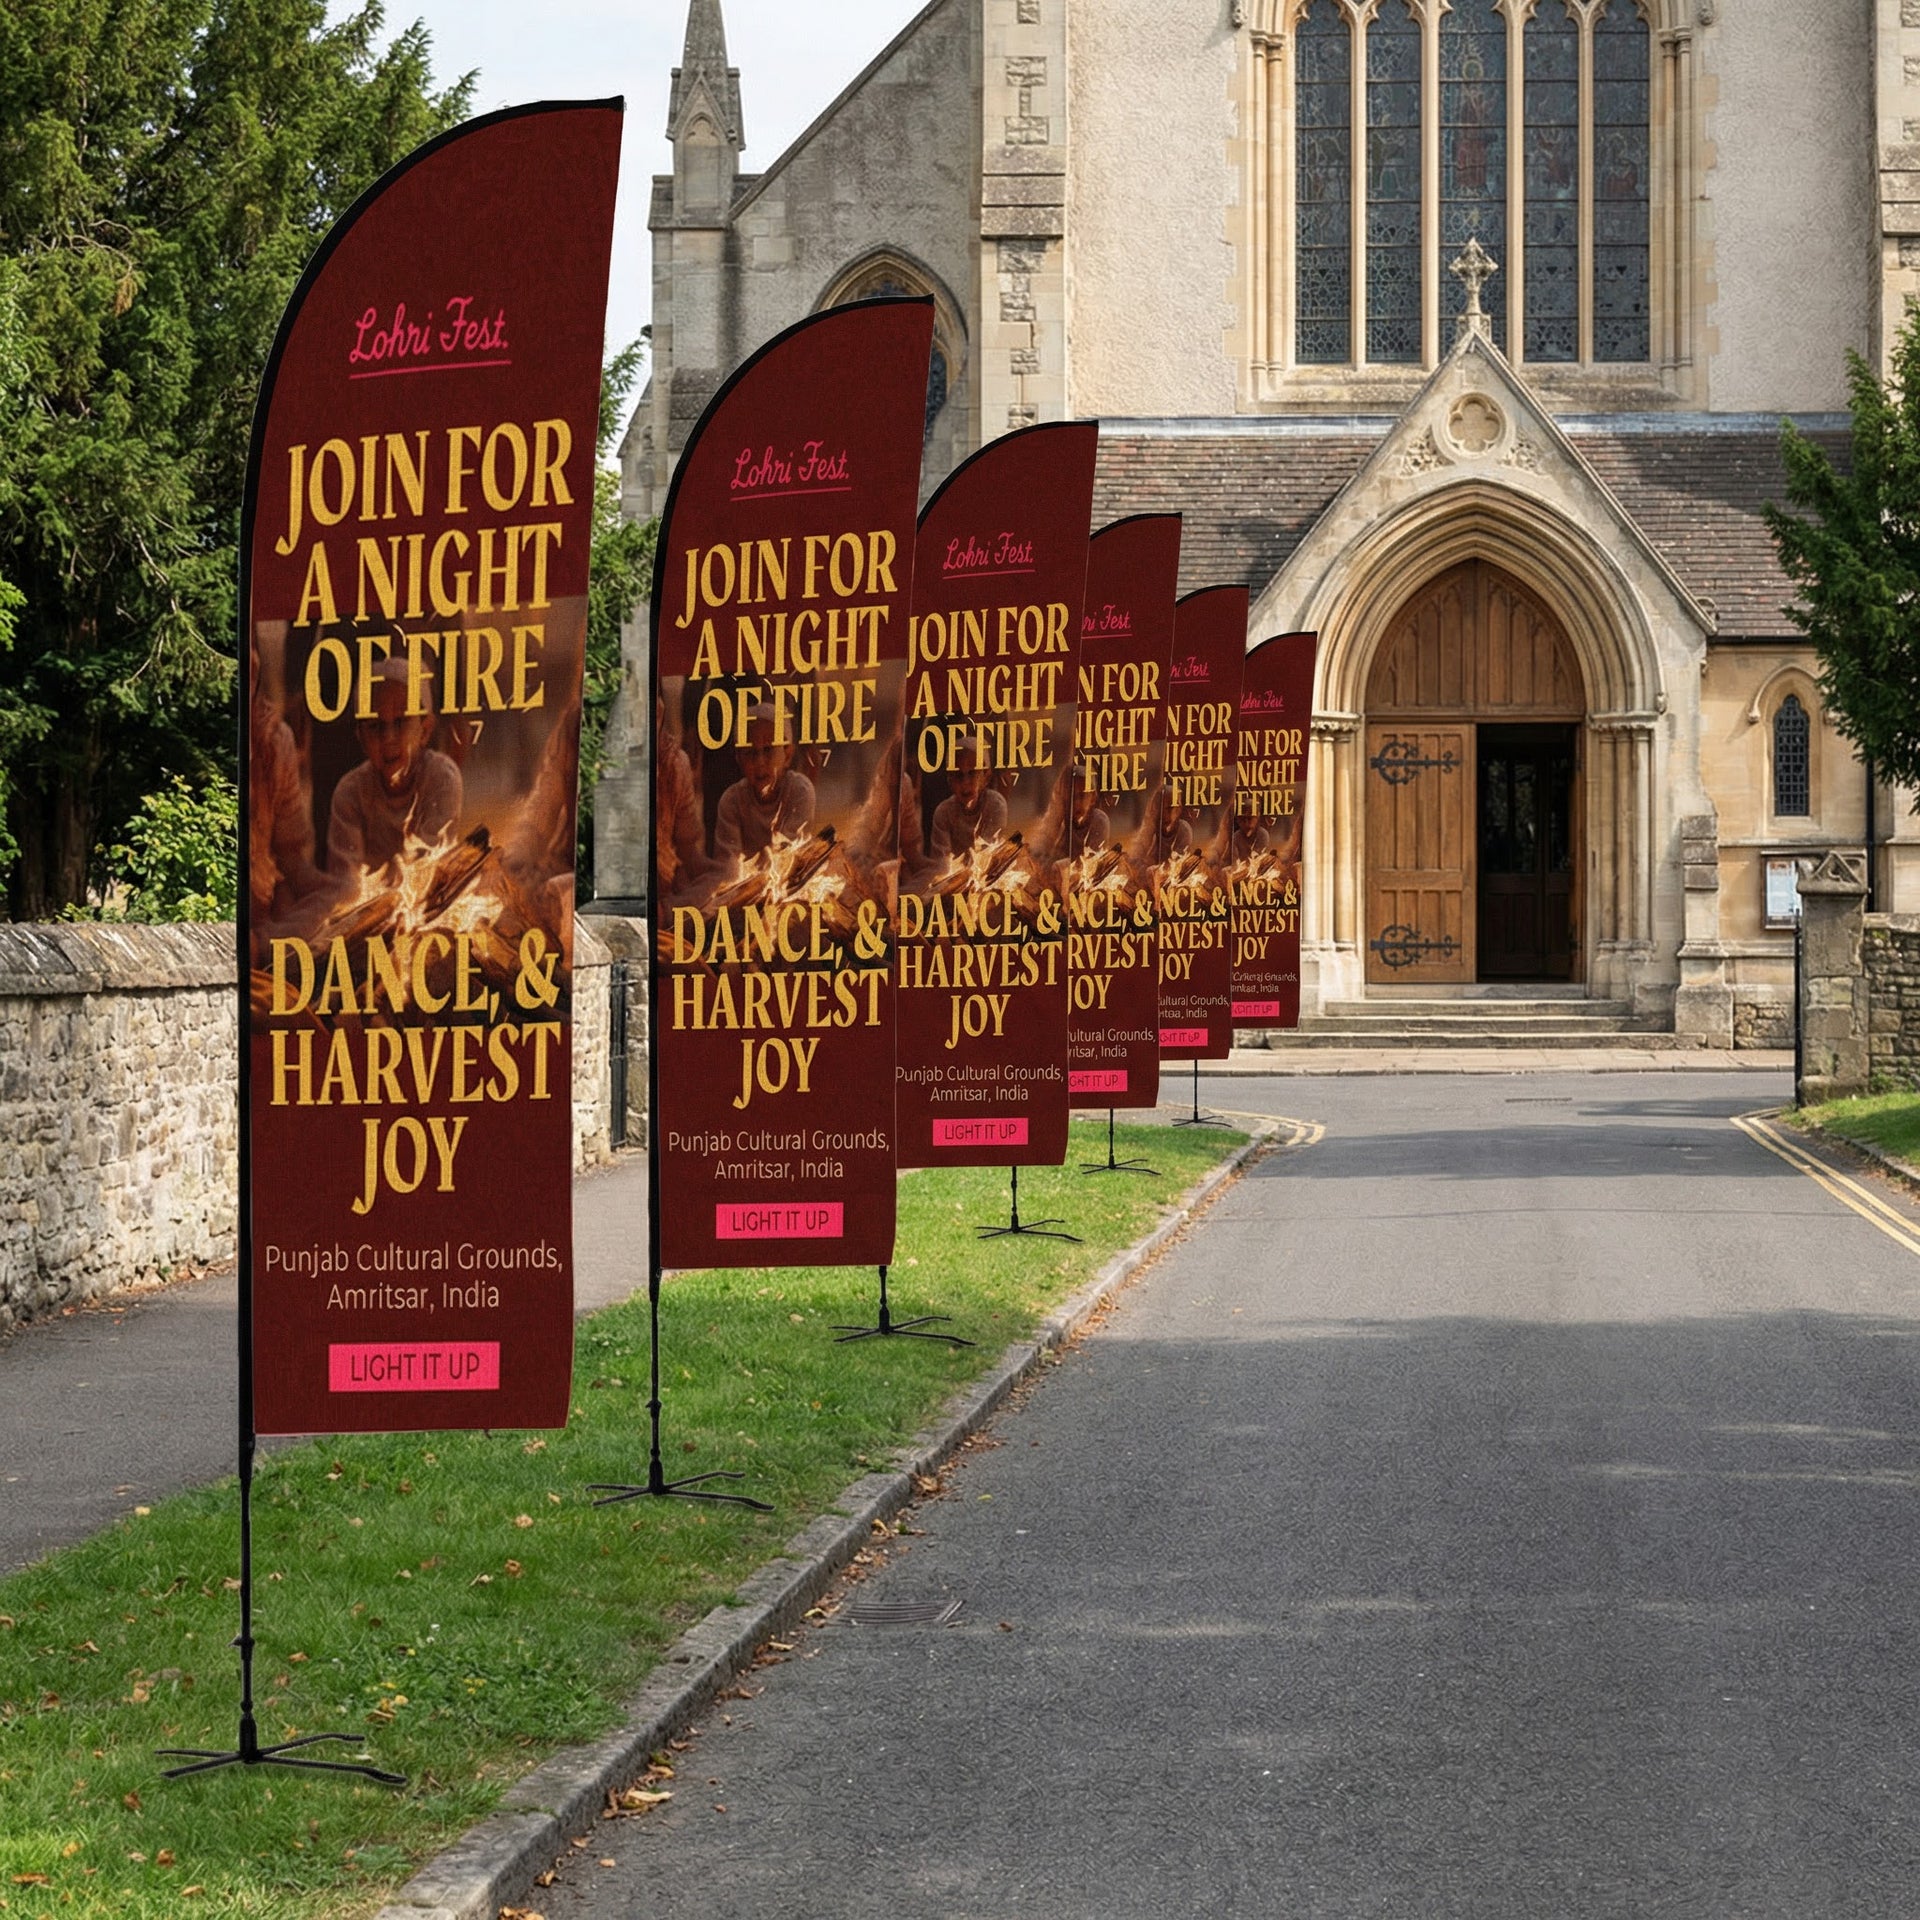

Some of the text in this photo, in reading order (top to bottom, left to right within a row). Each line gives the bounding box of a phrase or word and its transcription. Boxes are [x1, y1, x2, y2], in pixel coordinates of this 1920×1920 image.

[349, 302, 432, 363] Lohri
[275, 418, 574, 556] JOIN FOR
[730, 445, 794, 490] Lohri
[943, 536, 991, 570] Lohri
[293, 523, 563, 627] A NIGHT
[675, 529, 898, 629] JOIN FOR
[689, 605, 890, 681] A NIGHT
[906, 602, 1070, 678] JOIN FOR
[305, 624, 545, 722] OF FIRE
[911, 671, 938, 719] A
[947, 661, 1063, 716] NIGHT
[1102, 661, 1160, 702] FOR
[697, 679, 877, 750] OF FIRE
[1185, 702, 1232, 736] FOR
[917, 718, 1053, 774] OF FIRE
[1264, 729, 1303, 756] FOR
[1083, 752, 1147, 793] FIRE
[1171, 774, 1223, 807] FIRE
[1251, 789, 1295, 816] FIRE
[1068, 889, 1153, 934] NCE, &
[1159, 886, 1227, 920] NCE, &
[1284, 880, 1297, 905] &
[671, 899, 888, 970] DANCE, &
[899, 889, 1062, 942] DANCE, &
[1158, 921, 1228, 949] RVEST
[898, 941, 1062, 988] HARVEST
[1067, 932, 1154, 969] RVEST
[1234, 936, 1269, 967] JOY
[270, 928, 561, 1024] DANCE, &
[1067, 974, 1113, 1015] JOY
[671, 968, 889, 1030] HARVEST
[945, 994, 1011, 1050] JOY
[1068, 1028, 1105, 1042] ultural
[1107, 1028, 1156, 1043] Grounds,
[270, 1022, 563, 1106] HARVEST
[1101, 1045, 1127, 1058] India
[732, 1037, 821, 1110] JOY
[896, 1064, 1064, 1085] Punjab Cultural Grounds,
[930, 1084, 1028, 1103] Amritsar, India
[1069, 1075, 1090, 1088] GHT
[1104, 1074, 1118, 1087] UP
[668, 1127, 890, 1157] Punjab Cultural Grounds,
[945, 1124, 1017, 1140] LIGHT IT UP
[352, 1116, 469, 1215] JOY
[714, 1158, 844, 1182] Amritsar, India
[732, 1211, 830, 1233] LIGHT IT UP
[266, 1239, 563, 1278] Punjab Cultural Grounds,
[327, 1280, 500, 1314] Amritsar, India
[351, 1352, 480, 1383] LIGHT IT UP
